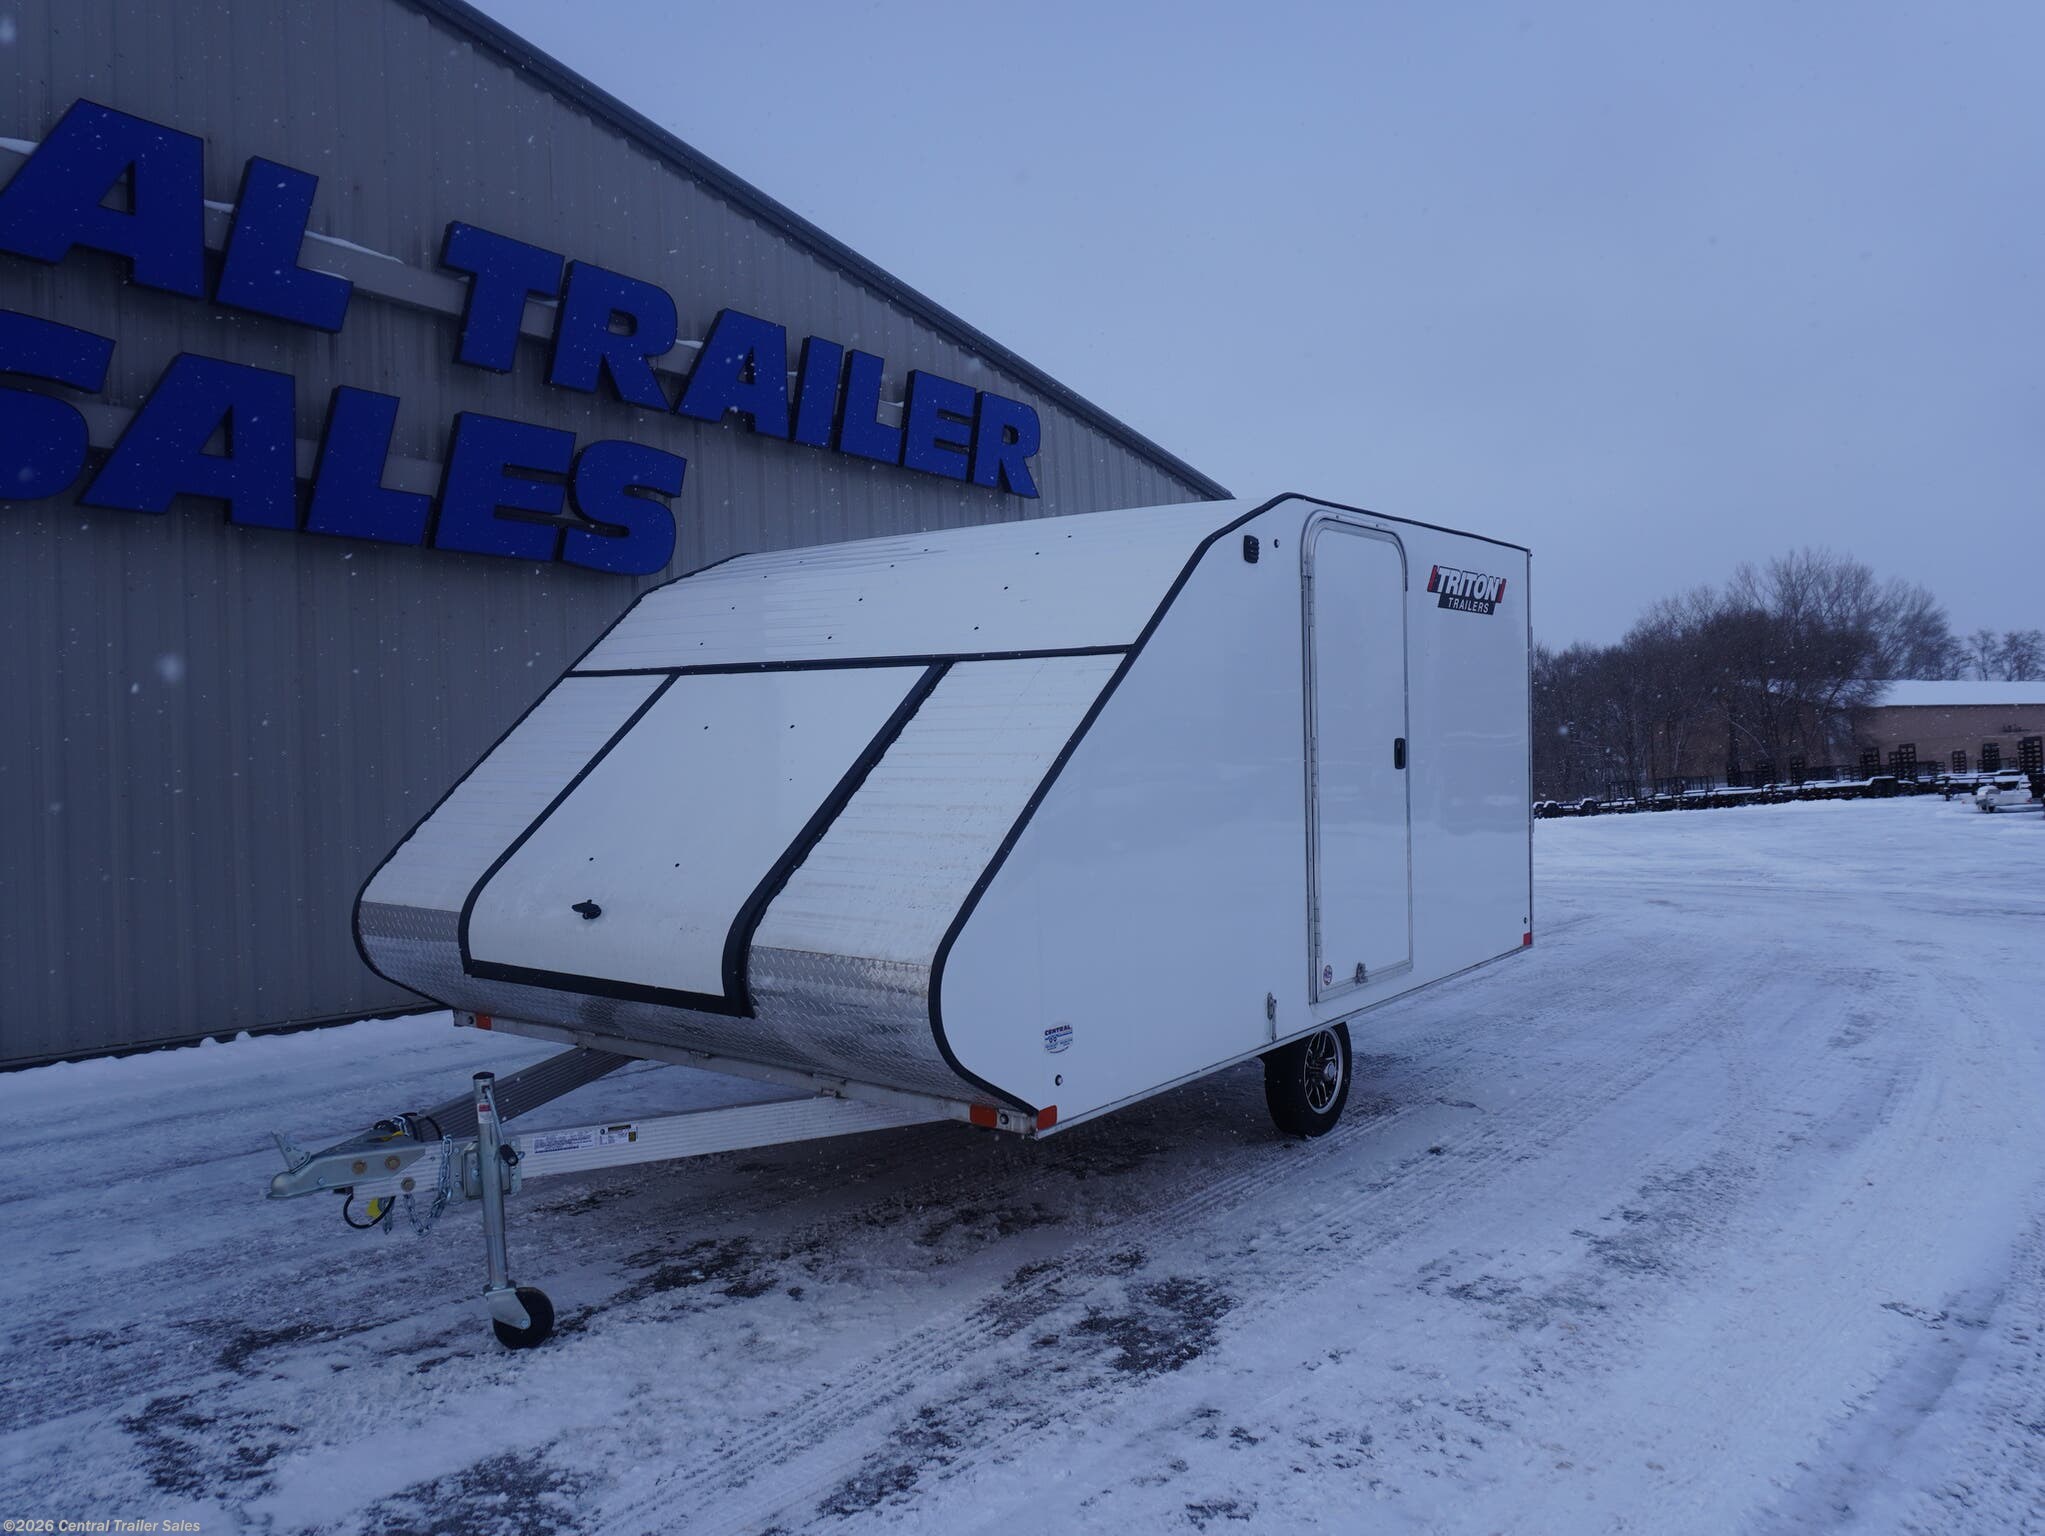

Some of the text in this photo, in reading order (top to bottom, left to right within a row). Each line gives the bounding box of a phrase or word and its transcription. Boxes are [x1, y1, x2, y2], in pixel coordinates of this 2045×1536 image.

[439, 220, 1040, 499] TRAILER
[1437, 565, 1500, 602] TRITON
[1448, 597, 1489, 614] TRAILERS
[1044, 1024, 1072, 1036] CENTRAL
